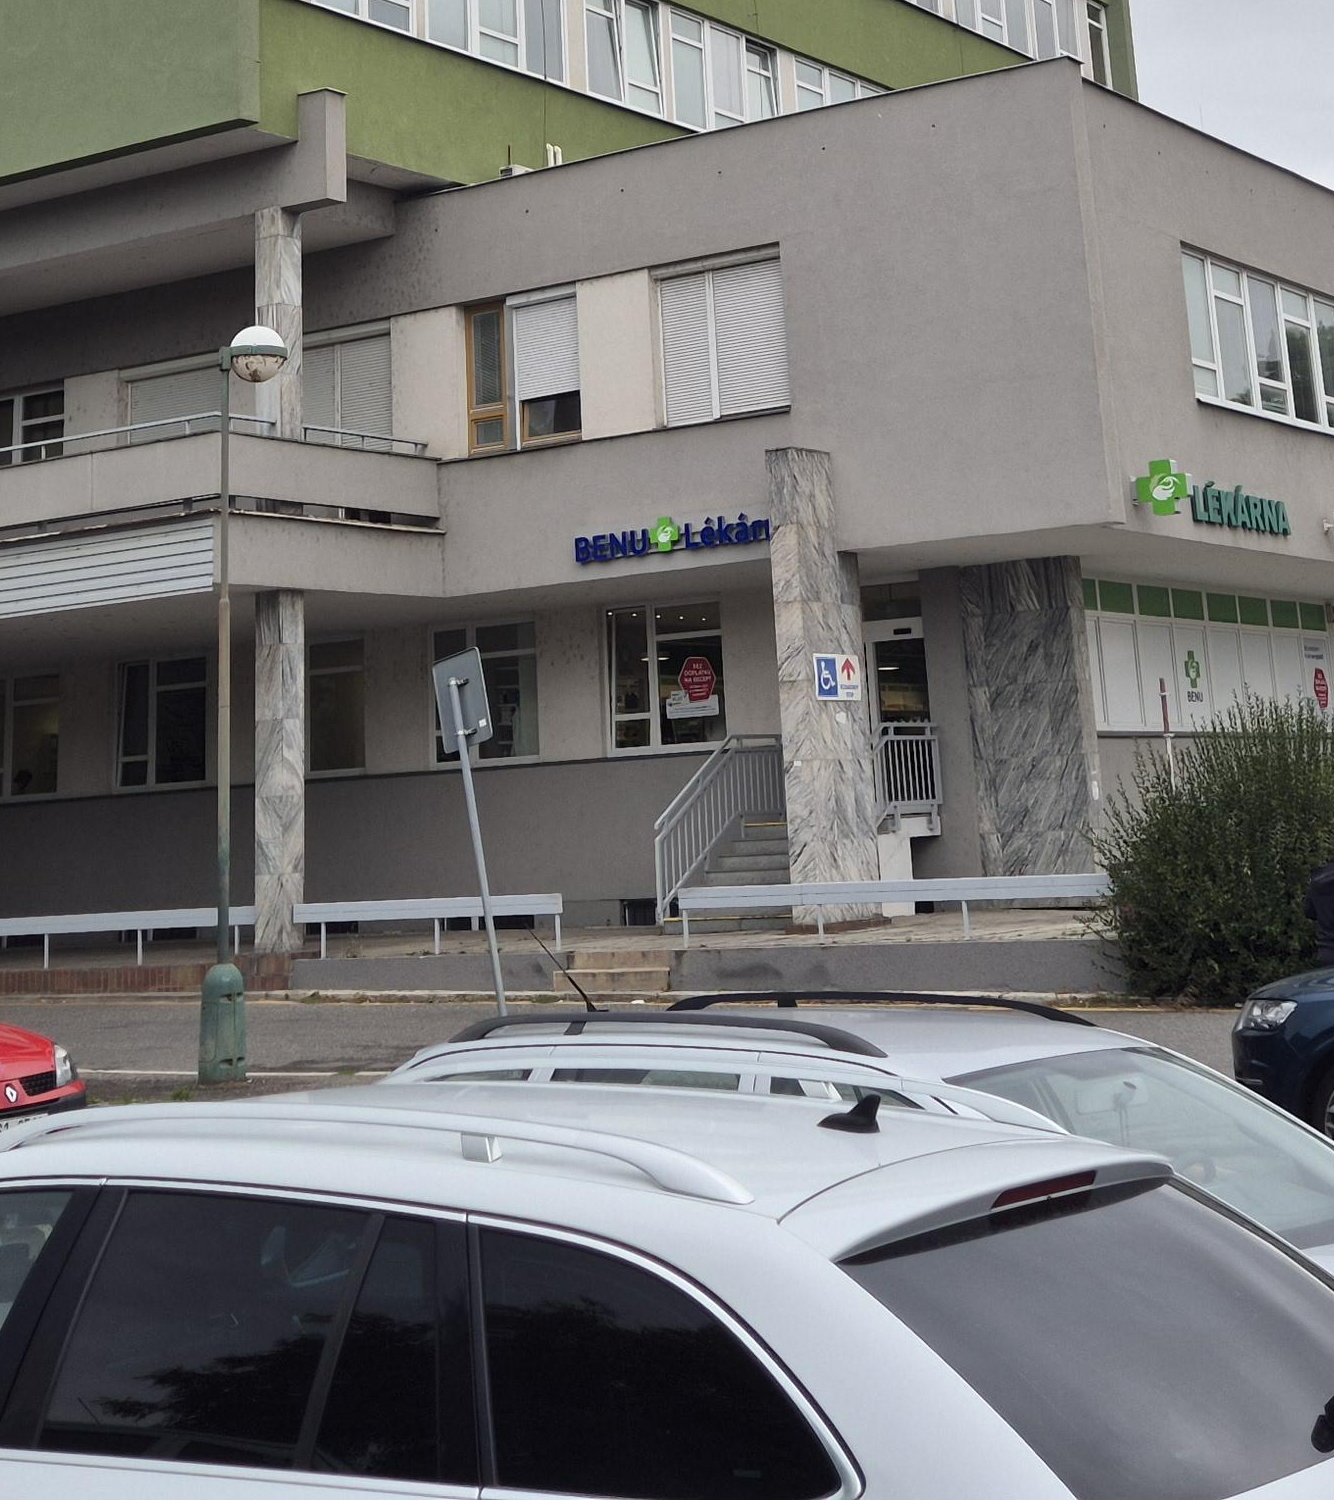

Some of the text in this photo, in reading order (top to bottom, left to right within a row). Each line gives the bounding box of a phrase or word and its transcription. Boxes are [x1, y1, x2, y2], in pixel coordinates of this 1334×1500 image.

[1191, 481, 1291, 536] LÉKÁRNA
[574, 528, 651, 564] BENU
[1187, 690, 1204, 703] BENU
